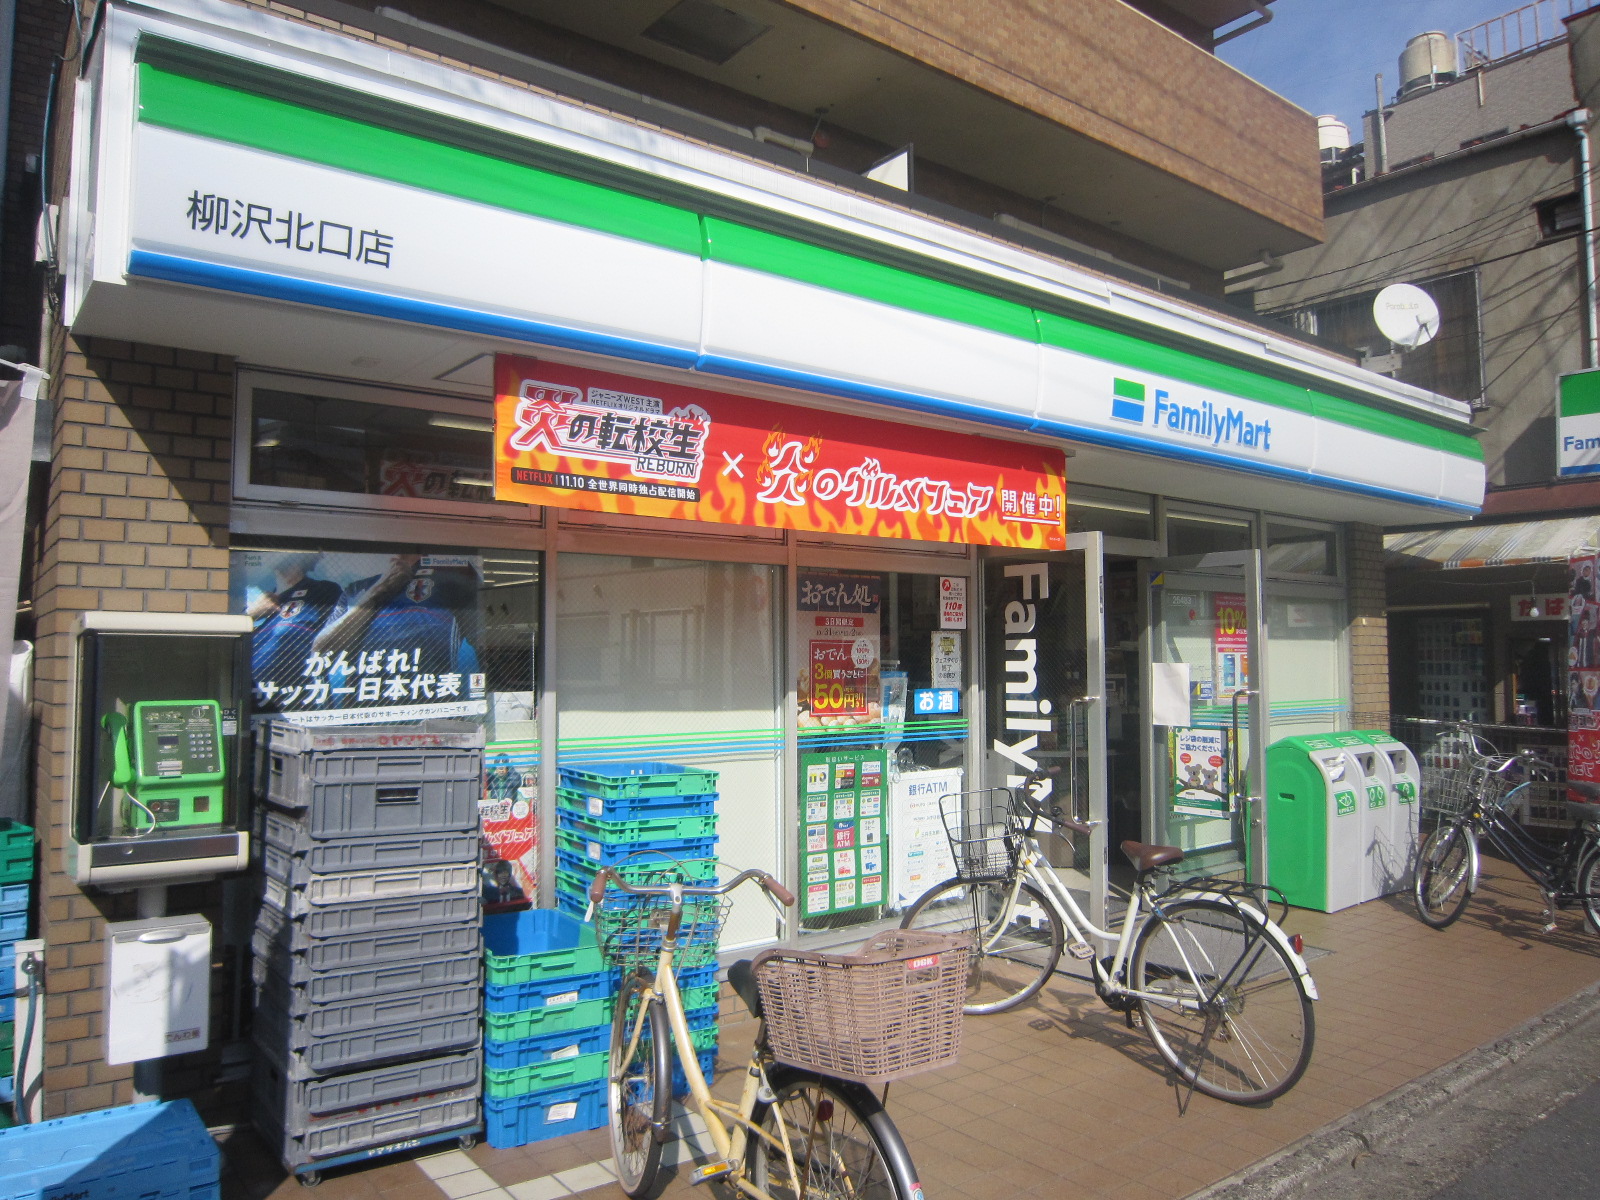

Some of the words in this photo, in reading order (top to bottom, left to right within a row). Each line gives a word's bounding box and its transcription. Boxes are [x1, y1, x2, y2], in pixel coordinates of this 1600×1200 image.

[186, 190, 394, 269] 柳沢北口店
[515, 384, 703, 460] 炎の転校生
[1153, 388, 1272, 451] FamilyMart
[635, 457, 696, 478] REBORN
[756, 440, 994, 519] 炎のグルメフェア
[1001, 488, 1061, 518] 開催中!
[516, 470, 553, 485] NETFLIX
[560, 475, 585, 489] 11.10
[587, 480, 697, 500] 全世界同時独占配信開始
[801, 579, 872, 607] おでん処
[303, 647, 422, 677] がんばれ!
[813, 647, 848, 661] おでん
[814, 662, 864, 680] 3個買うごとに
[252, 672, 462, 708] サッカー日本代表
[919, 690, 954, 711] お酒
[908, 781, 948, 796] 銀行ATM
